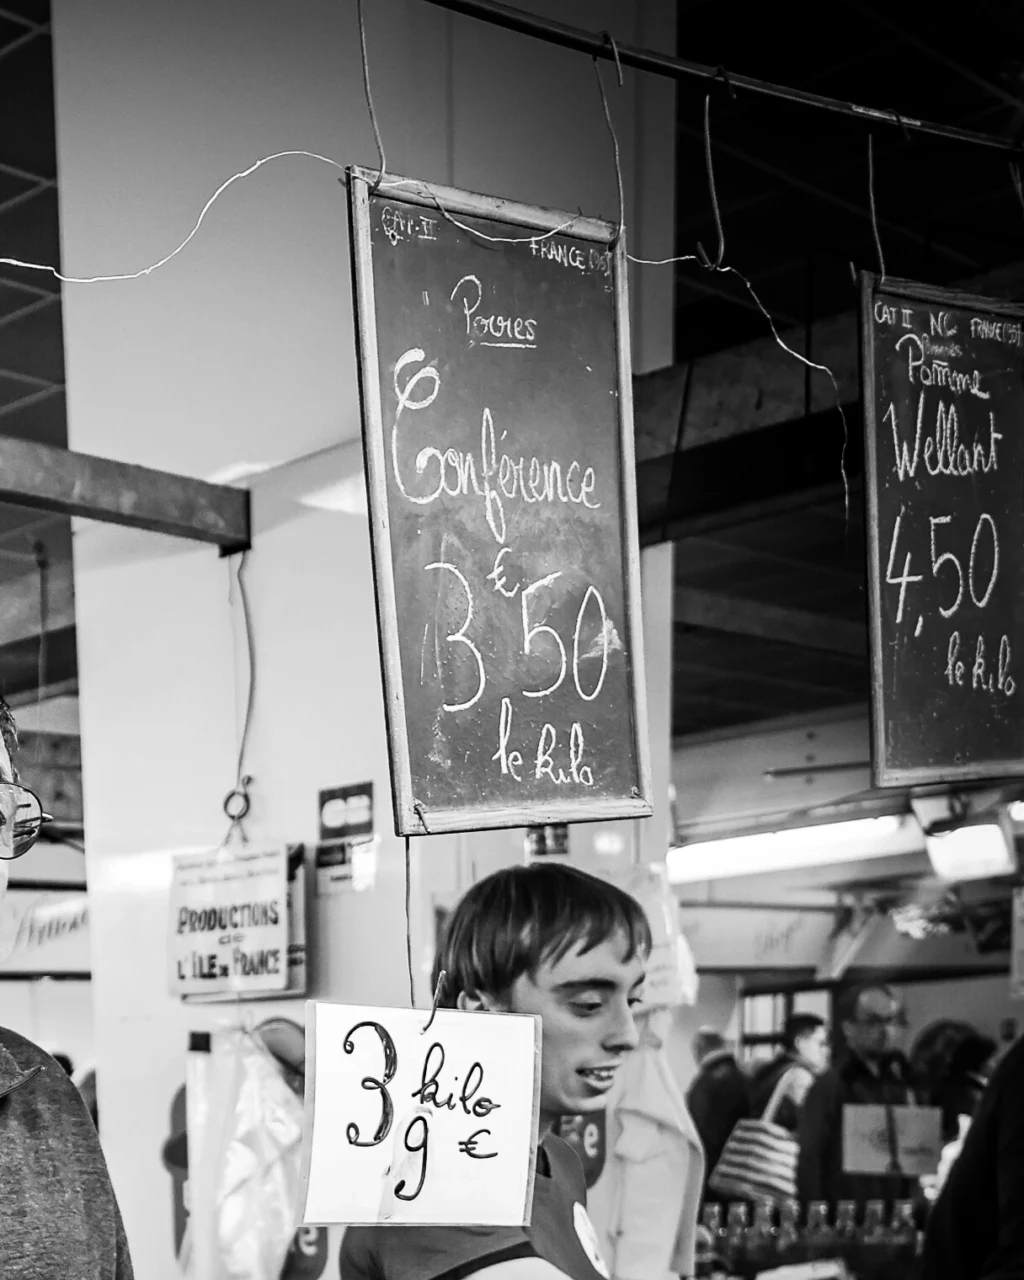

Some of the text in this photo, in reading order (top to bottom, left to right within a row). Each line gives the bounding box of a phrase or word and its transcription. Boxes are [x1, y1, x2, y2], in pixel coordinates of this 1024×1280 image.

[875, 302, 898, 325] CAT
[882, 388, 1004, 482] Wellant
[886, 513, 1000, 638] 4,50
[945, 630, 1016, 696] le kilo
[492, 697, 594, 786] le kilo
[177, 901, 279, 934] PRODUCTIONS
[343, 1021, 502, 1147] 3 kilo
[458, 1129, 499, 1160] €
